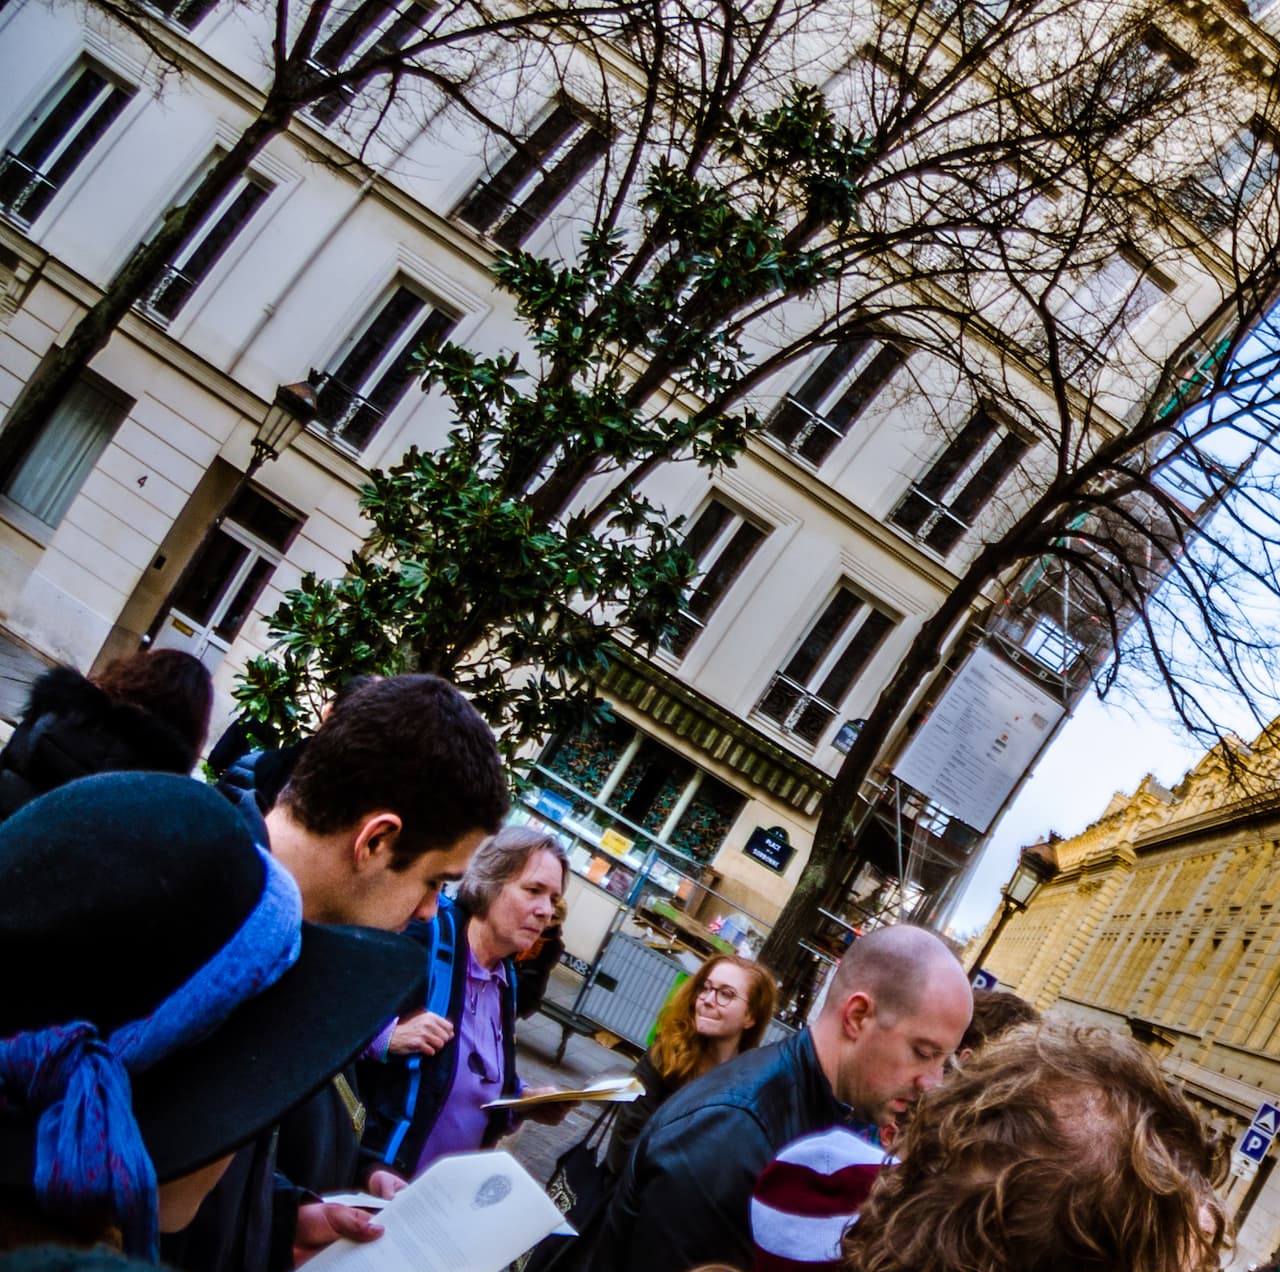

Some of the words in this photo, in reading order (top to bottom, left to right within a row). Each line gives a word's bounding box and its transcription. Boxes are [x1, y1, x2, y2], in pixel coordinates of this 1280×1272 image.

[137, 475, 148, 488] 4
[766, 838, 782, 852] PLACE
[753, 848, 780, 868] SORBONNE
[971, 974, 988, 990] P
[1246, 1135, 1262, 1152] P
